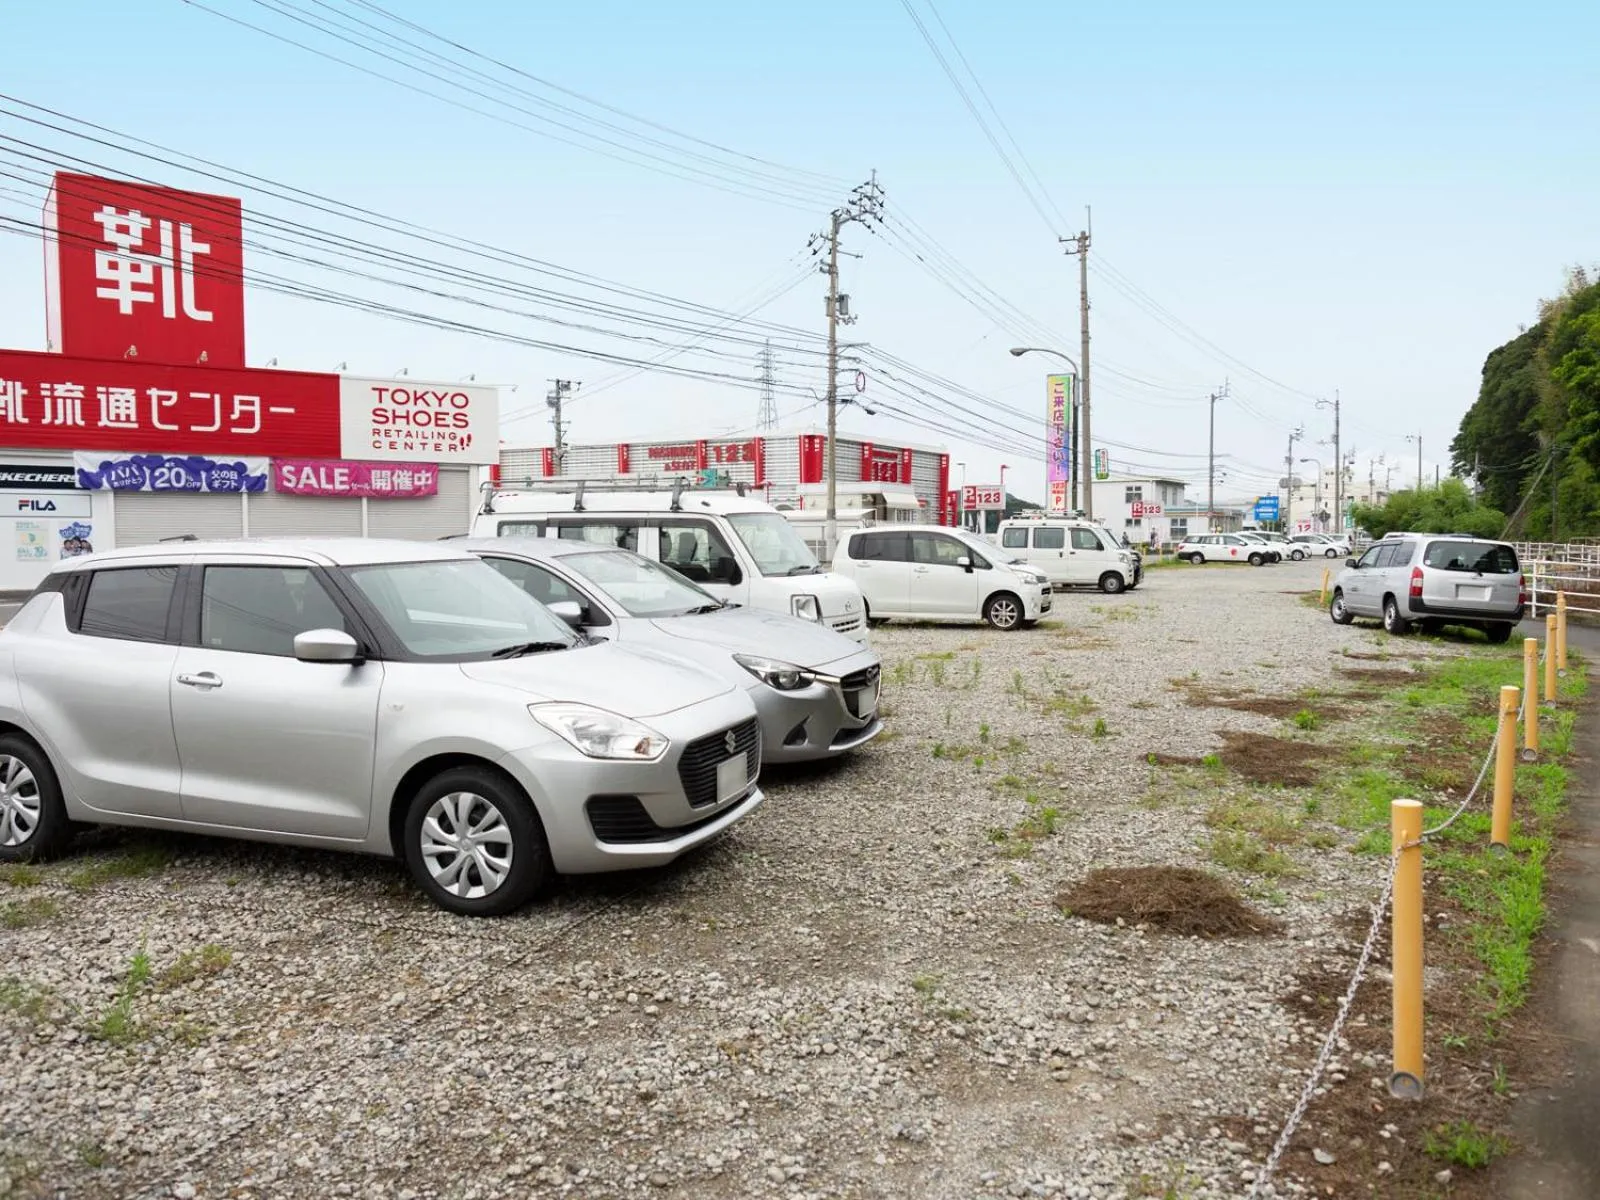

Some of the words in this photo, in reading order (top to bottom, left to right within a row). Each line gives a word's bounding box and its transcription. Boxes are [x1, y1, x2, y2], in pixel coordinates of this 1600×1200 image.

[93, 206, 213, 322] 靴
[371, 387, 469, 409] TOKYO
[0, 378, 295, 433] 靴流通センター
[371, 407, 469, 428] SHOES
[372, 428, 457, 440] RETAILING
[211, 470, 238, 480] 父の日
[281, 465, 350, 490] SALE
[371, 470, 432, 490] 開催中
[212, 480, 238, 489] ギフト
[977, 492, 1001, 503] 123
[18, 500, 56, 511] FILA
[1144, 505, 1161, 514] 123
